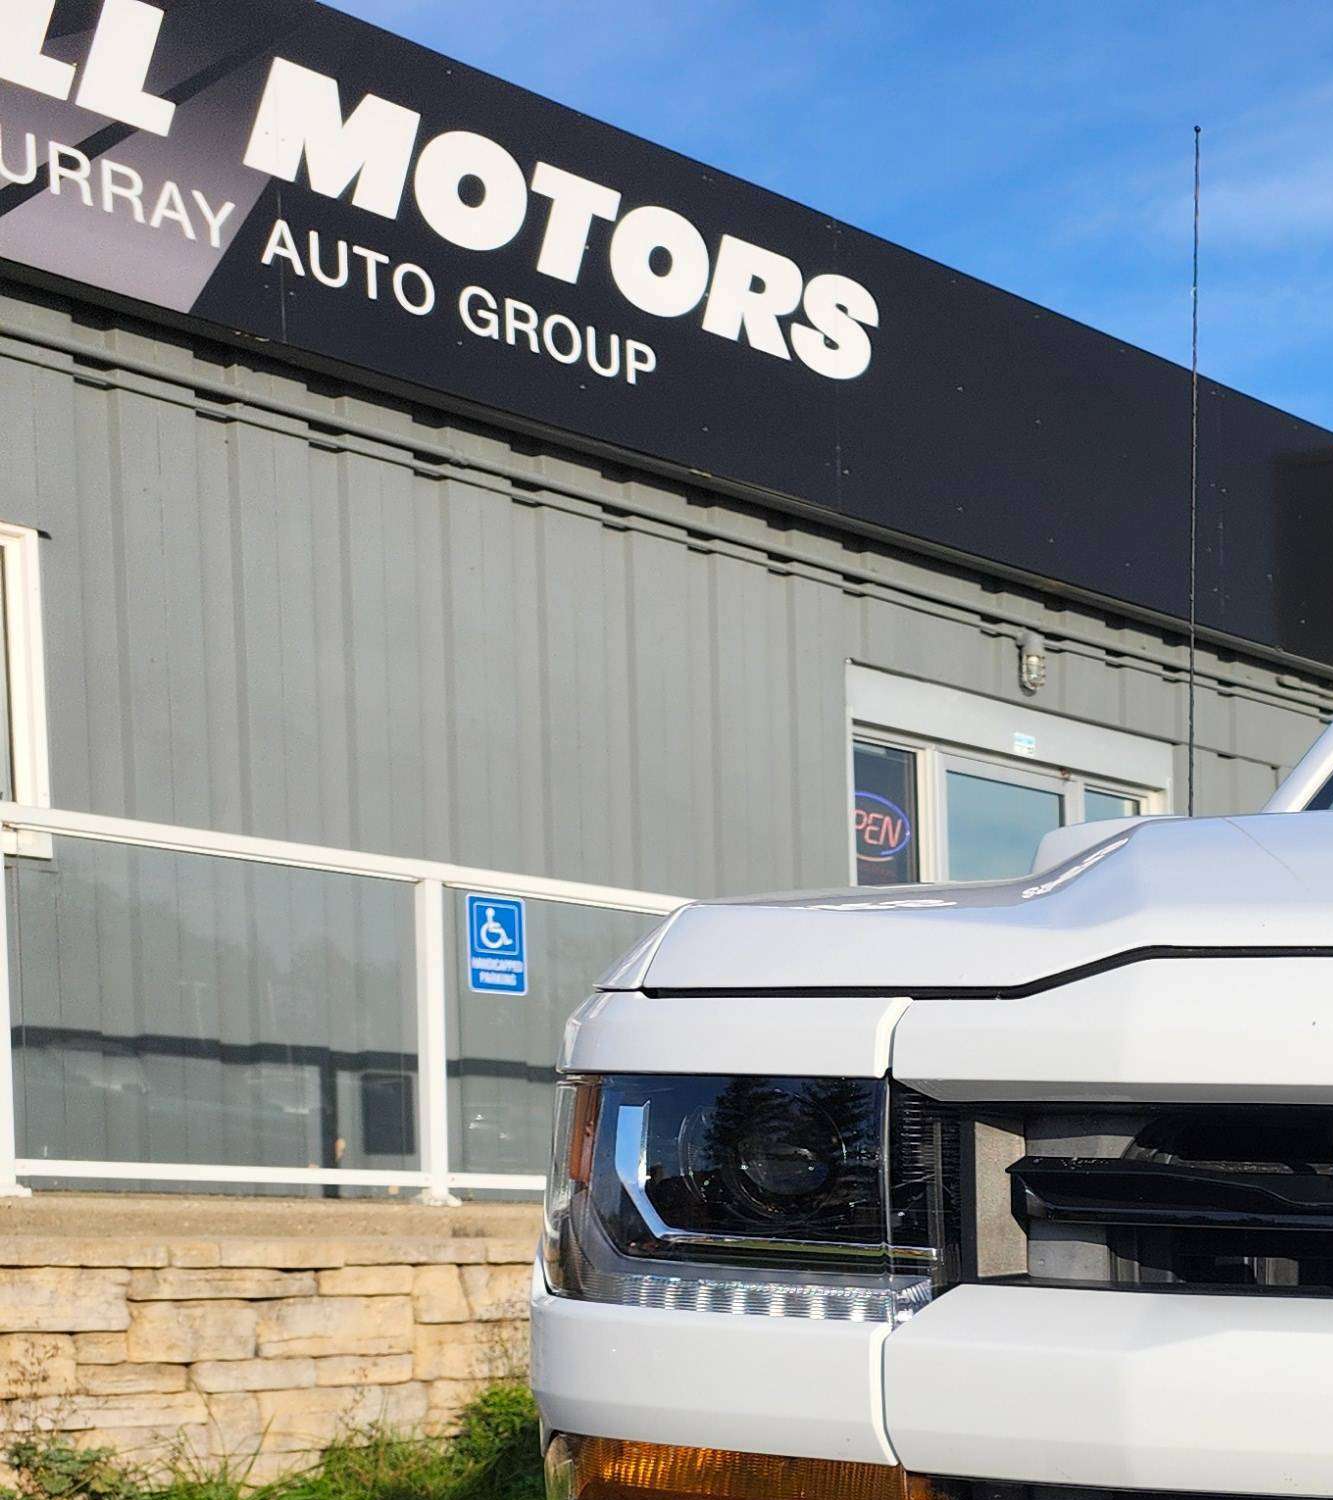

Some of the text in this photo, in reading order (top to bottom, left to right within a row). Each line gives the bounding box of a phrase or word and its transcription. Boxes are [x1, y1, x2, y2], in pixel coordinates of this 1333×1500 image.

[0, 122, 658, 385] URRAY AUTO GROUP
[243, 56, 879, 380] MOTORS
